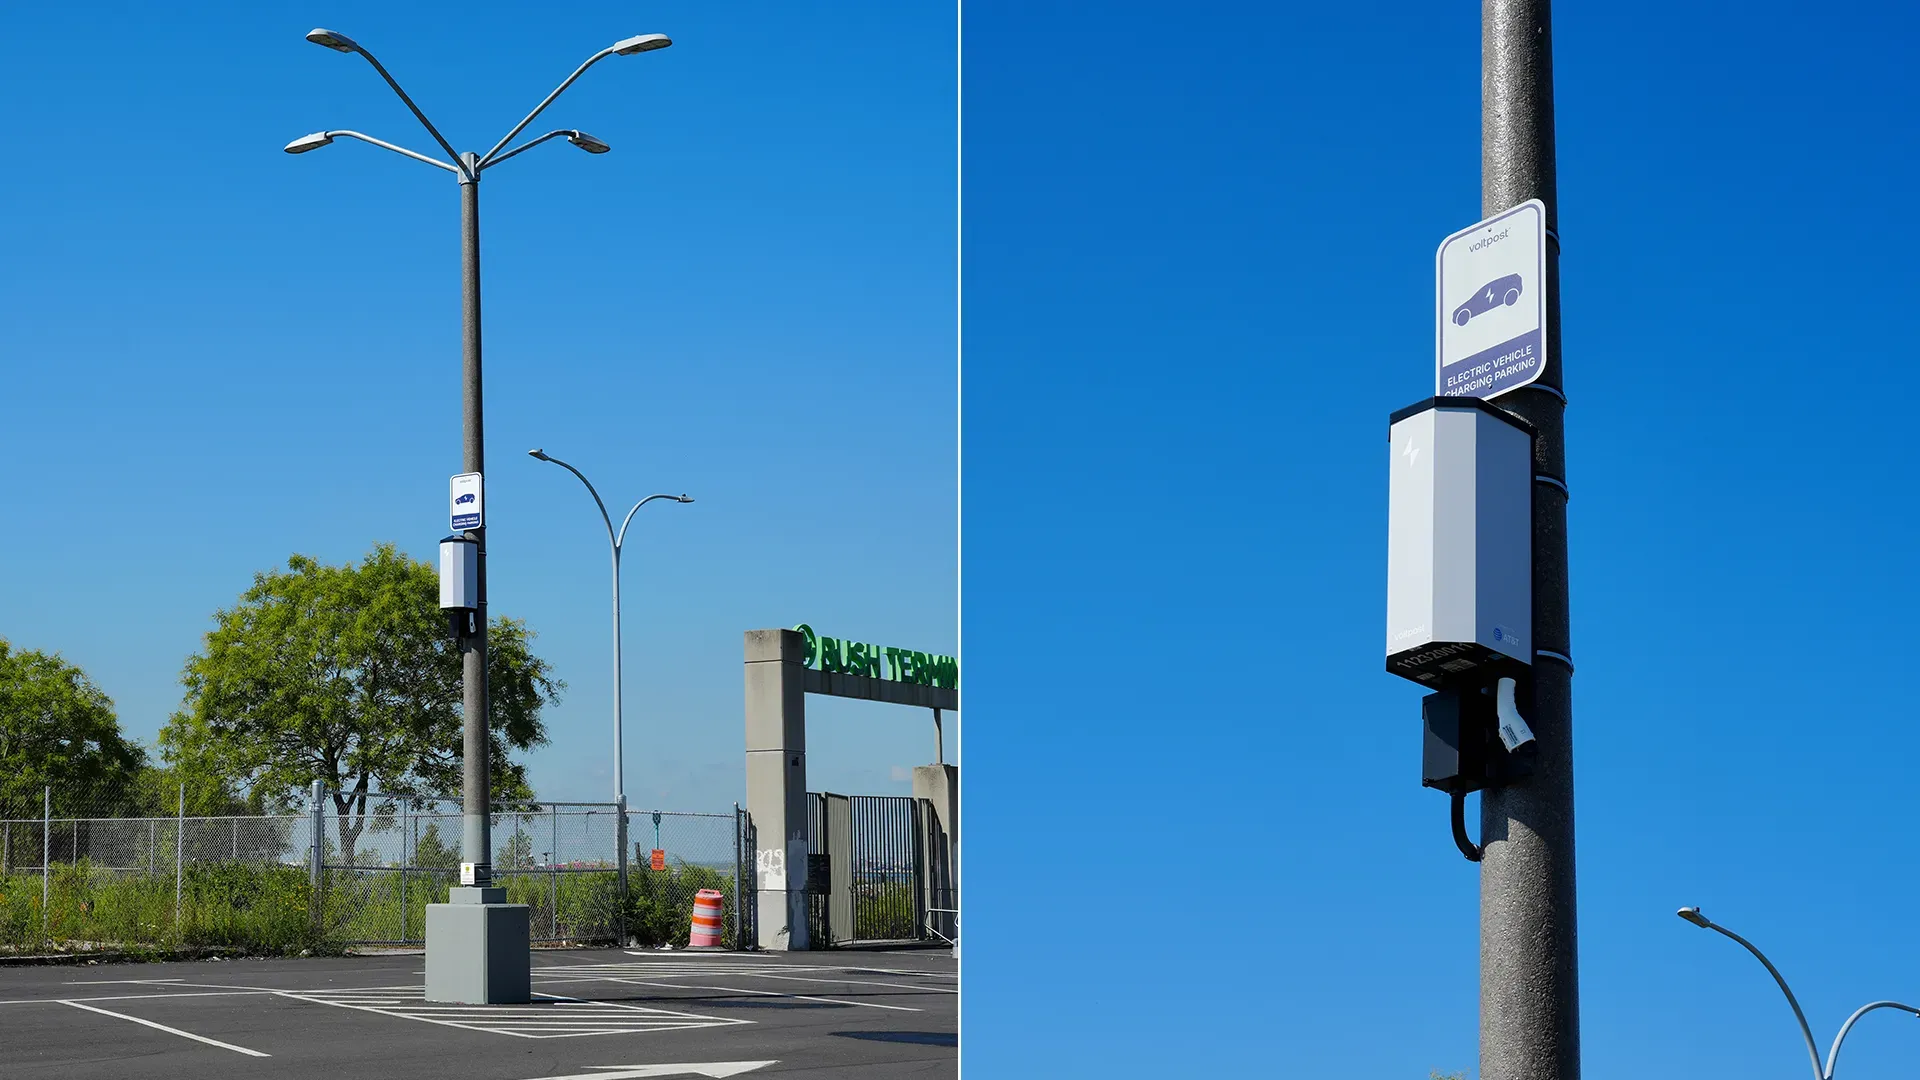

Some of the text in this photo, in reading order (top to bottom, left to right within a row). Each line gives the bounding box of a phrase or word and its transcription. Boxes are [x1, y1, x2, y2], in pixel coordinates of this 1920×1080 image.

[1469, 228, 1510, 252] voltpost
[1447, 344, 1533, 387] ELECTRIC VEHICLE
[1494, 357, 1536, 380] PARKING
[816, 636, 881, 679] BUSH
